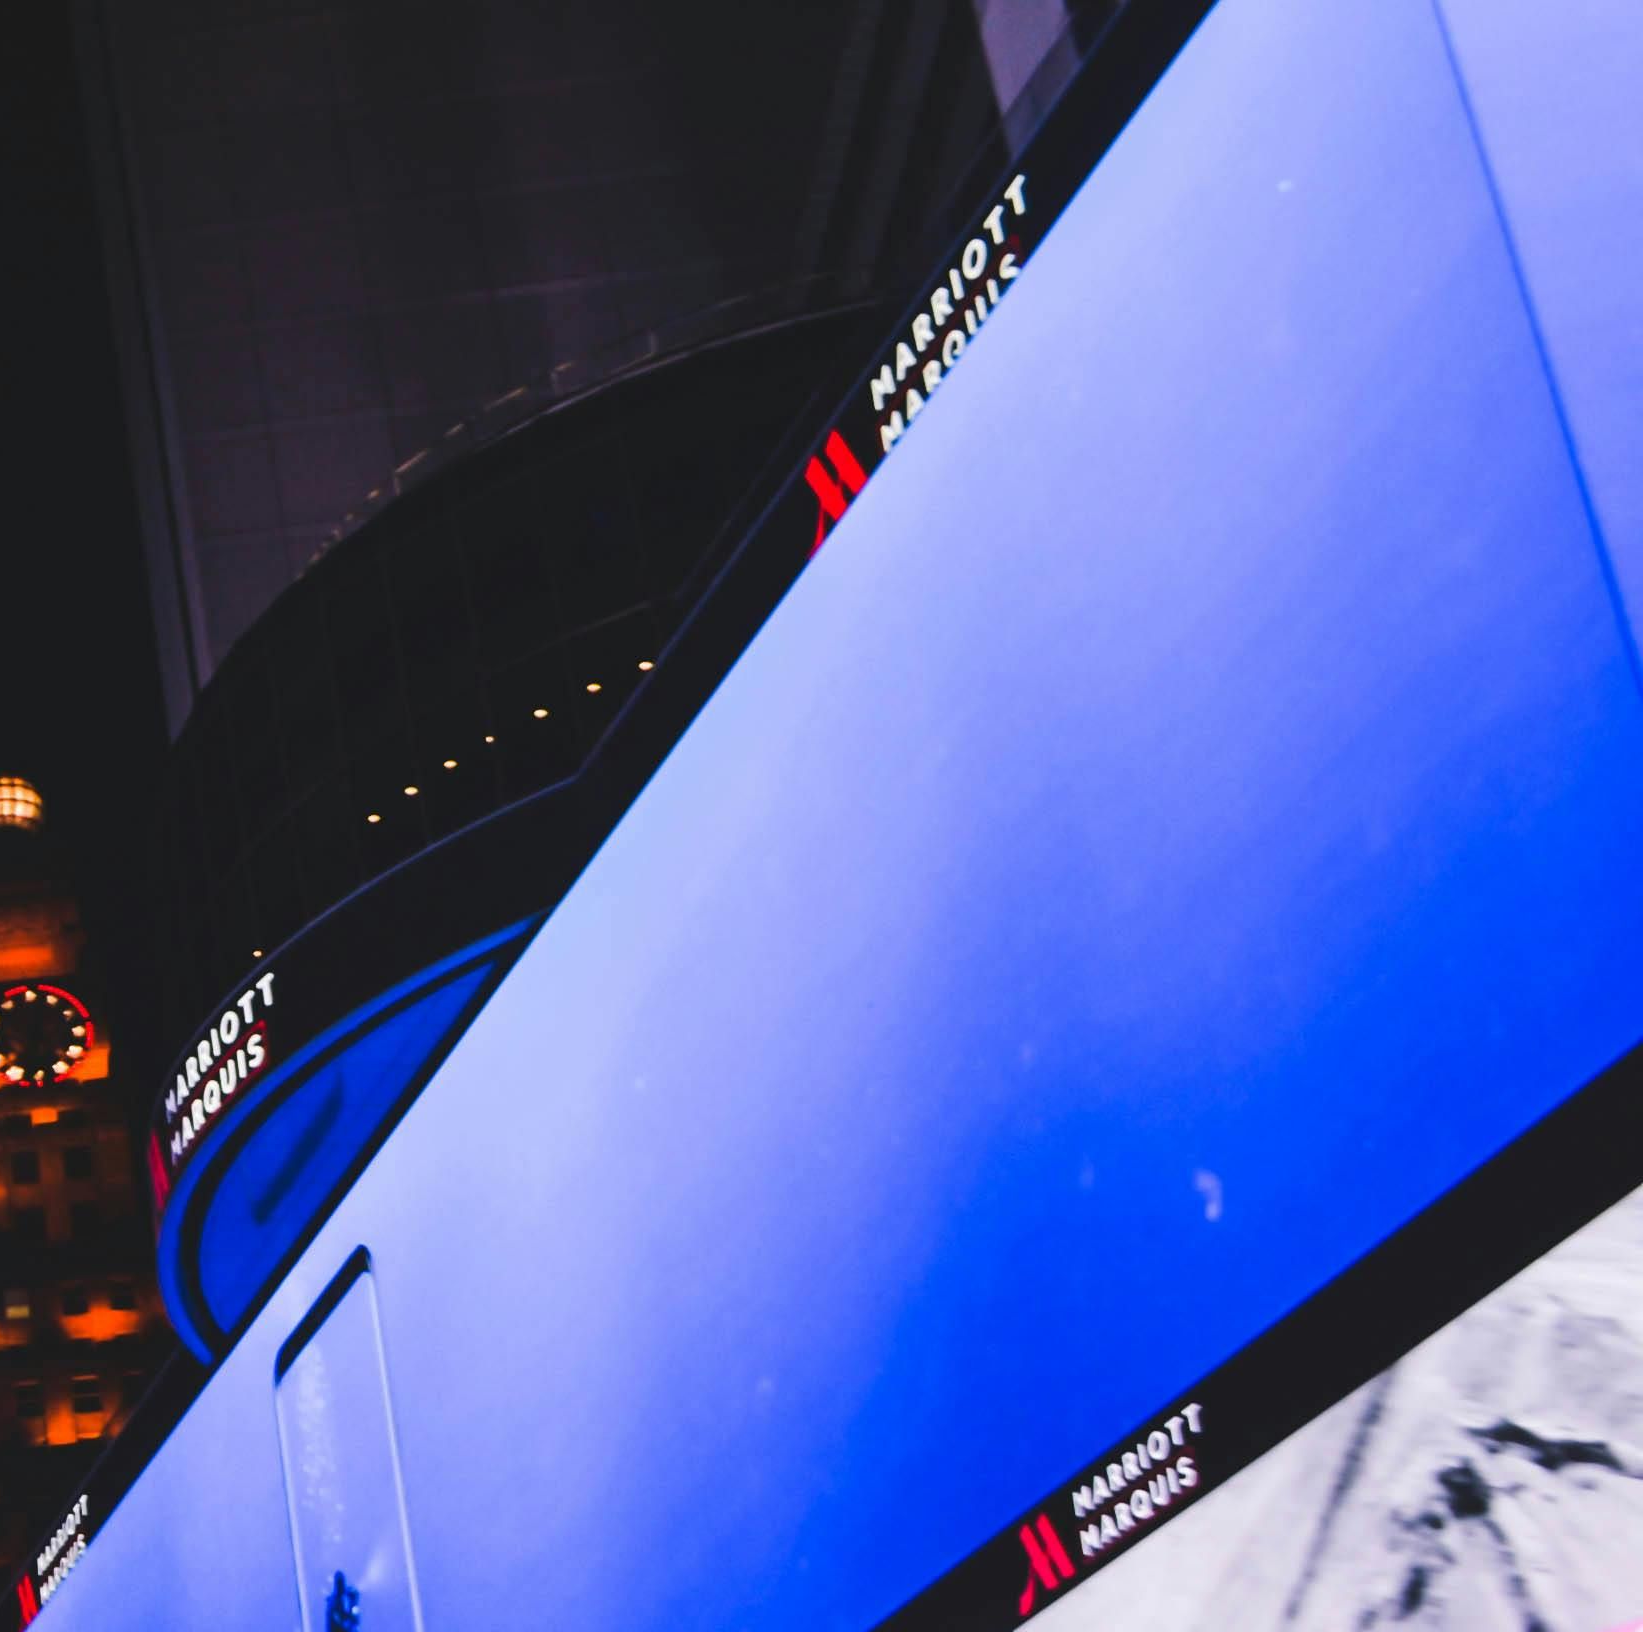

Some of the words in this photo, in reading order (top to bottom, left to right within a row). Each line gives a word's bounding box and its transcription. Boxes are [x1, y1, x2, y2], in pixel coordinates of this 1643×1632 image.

[870, 174, 1027, 411] MARRIOTT
[164, 972, 275, 1122] MARRIOTT
[170, 1033, 266, 1166] MARQUIS
[1071, 1402, 1204, 1517] MARRIOTT
[1079, 1456, 1199, 1557] MARQUIS
